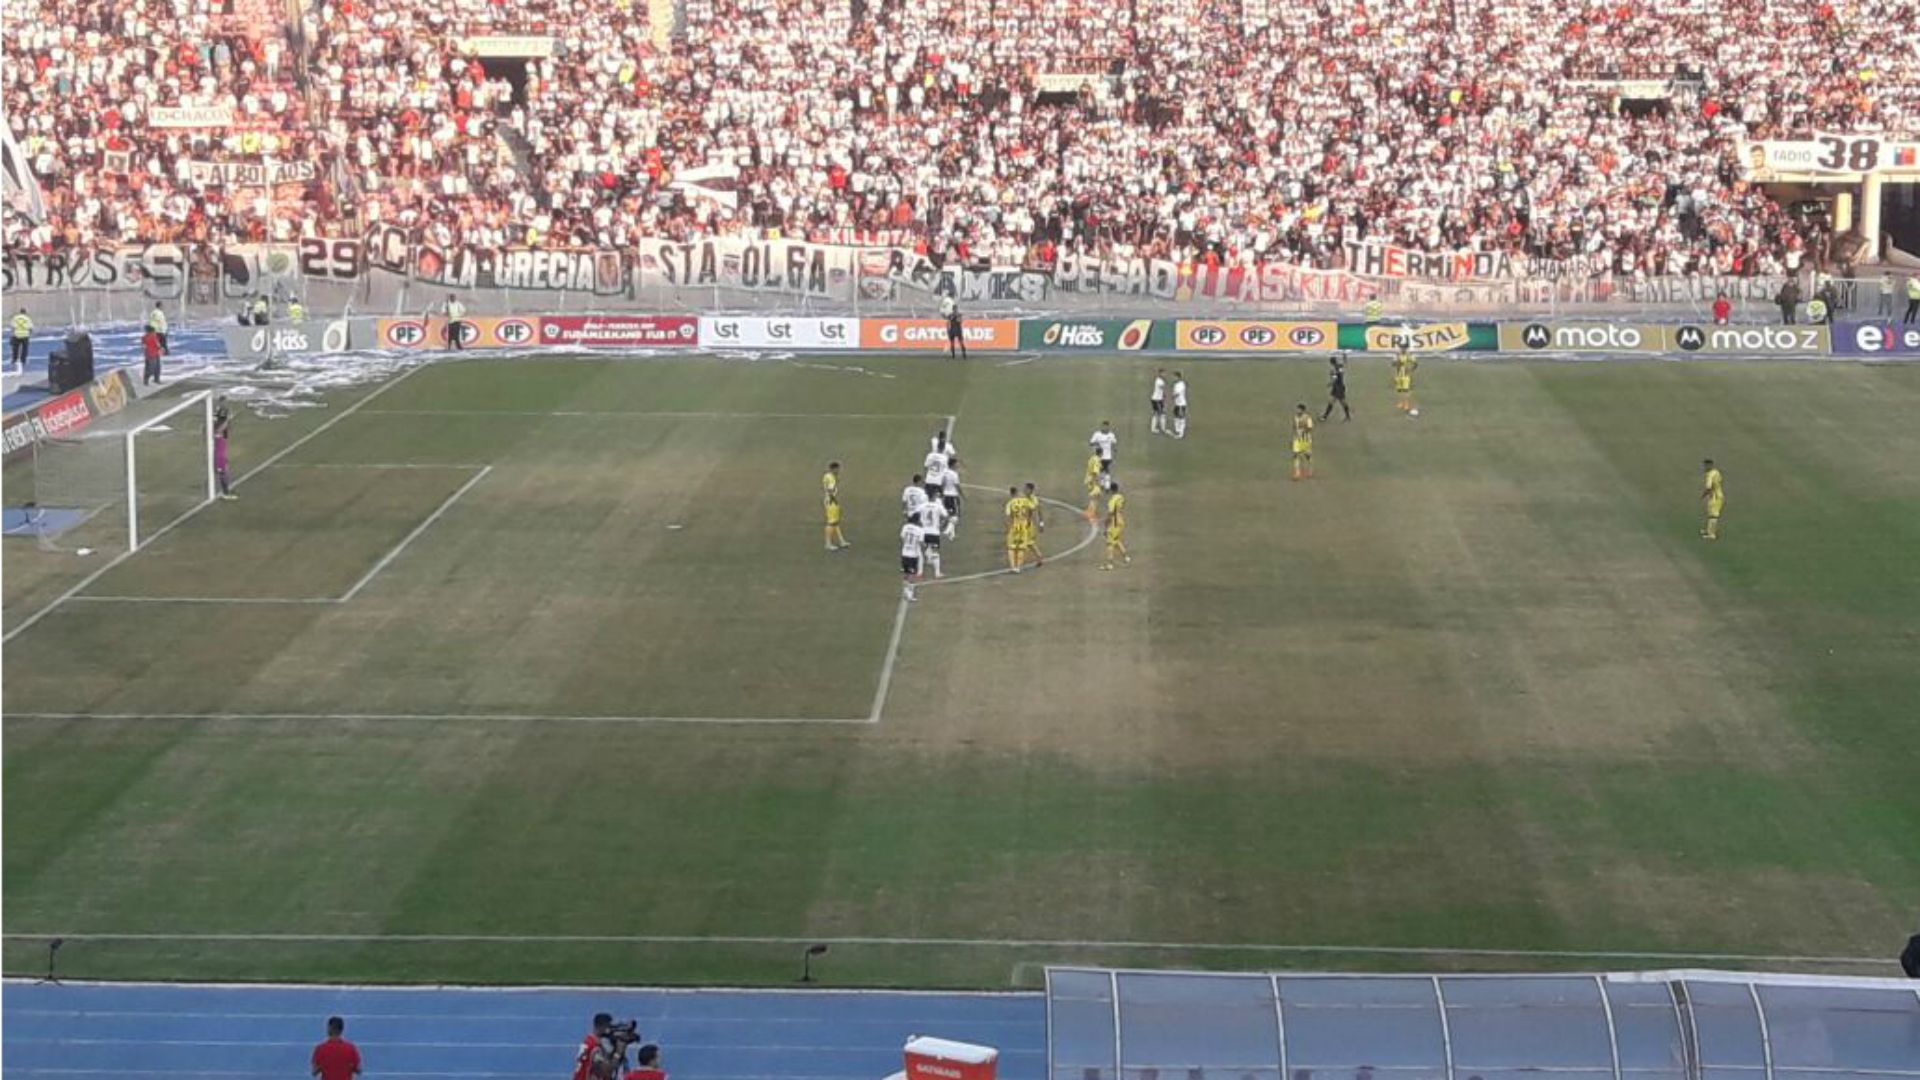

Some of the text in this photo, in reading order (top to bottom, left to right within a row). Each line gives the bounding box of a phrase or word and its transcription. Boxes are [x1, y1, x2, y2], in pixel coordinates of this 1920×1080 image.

[1817, 137, 1880, 171] 38
[301, 238, 358, 278] 29
[659, 241, 717, 285] STA
[396, 327, 416, 342] PF
[504, 325, 524, 342] PF
[904, 326, 995, 341] GATOADE
[1060, 325, 1104, 346] Hass
[1199, 328, 1217, 343] PF
[1248, 328, 1266, 343] PF
[1298, 328, 1316, 343] PF
[1556, 327, 1641, 347] moto
[1711, 327, 1797, 349] moto
